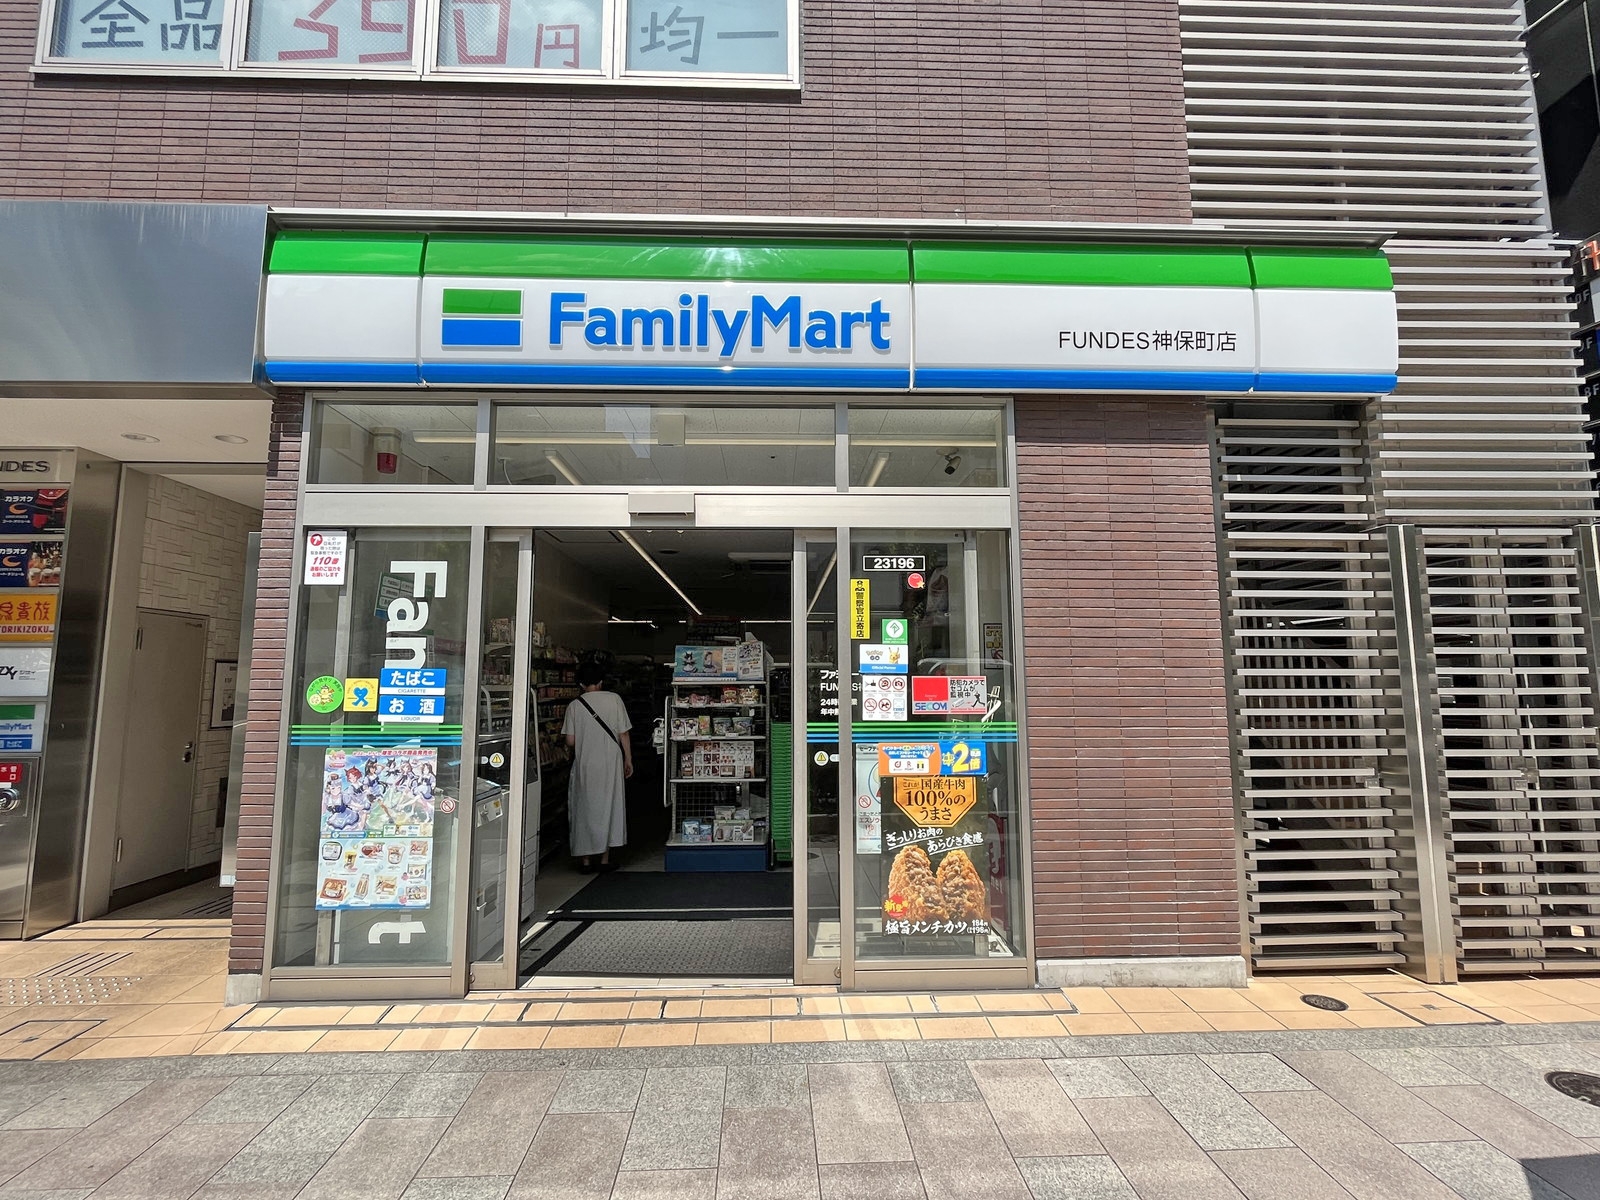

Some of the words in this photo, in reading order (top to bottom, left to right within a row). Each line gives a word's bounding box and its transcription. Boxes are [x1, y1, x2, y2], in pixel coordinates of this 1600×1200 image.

[549, 291, 893, 358] FamilyMart
[1059, 330, 1237, 352] FUNDES神保町店
[874, 558, 915, 569] 23196
[0, 625, 50, 634] ORIKIZOKU
[390, 670, 436, 686] たばこ
[949, 679, 985, 687] 防犯カメラで
[915, 702, 948, 711] SECOM
[921, 778, 966, 790] 国産牛肉
[905, 790, 966, 806] 100%の
[919, 806, 952, 821] うまさ
[885, 826, 943, 847] ぎっしりお肉の
[927, 831, 984, 853] あらびき食感
[885, 920, 968, 935] 極旨メンチカツ
